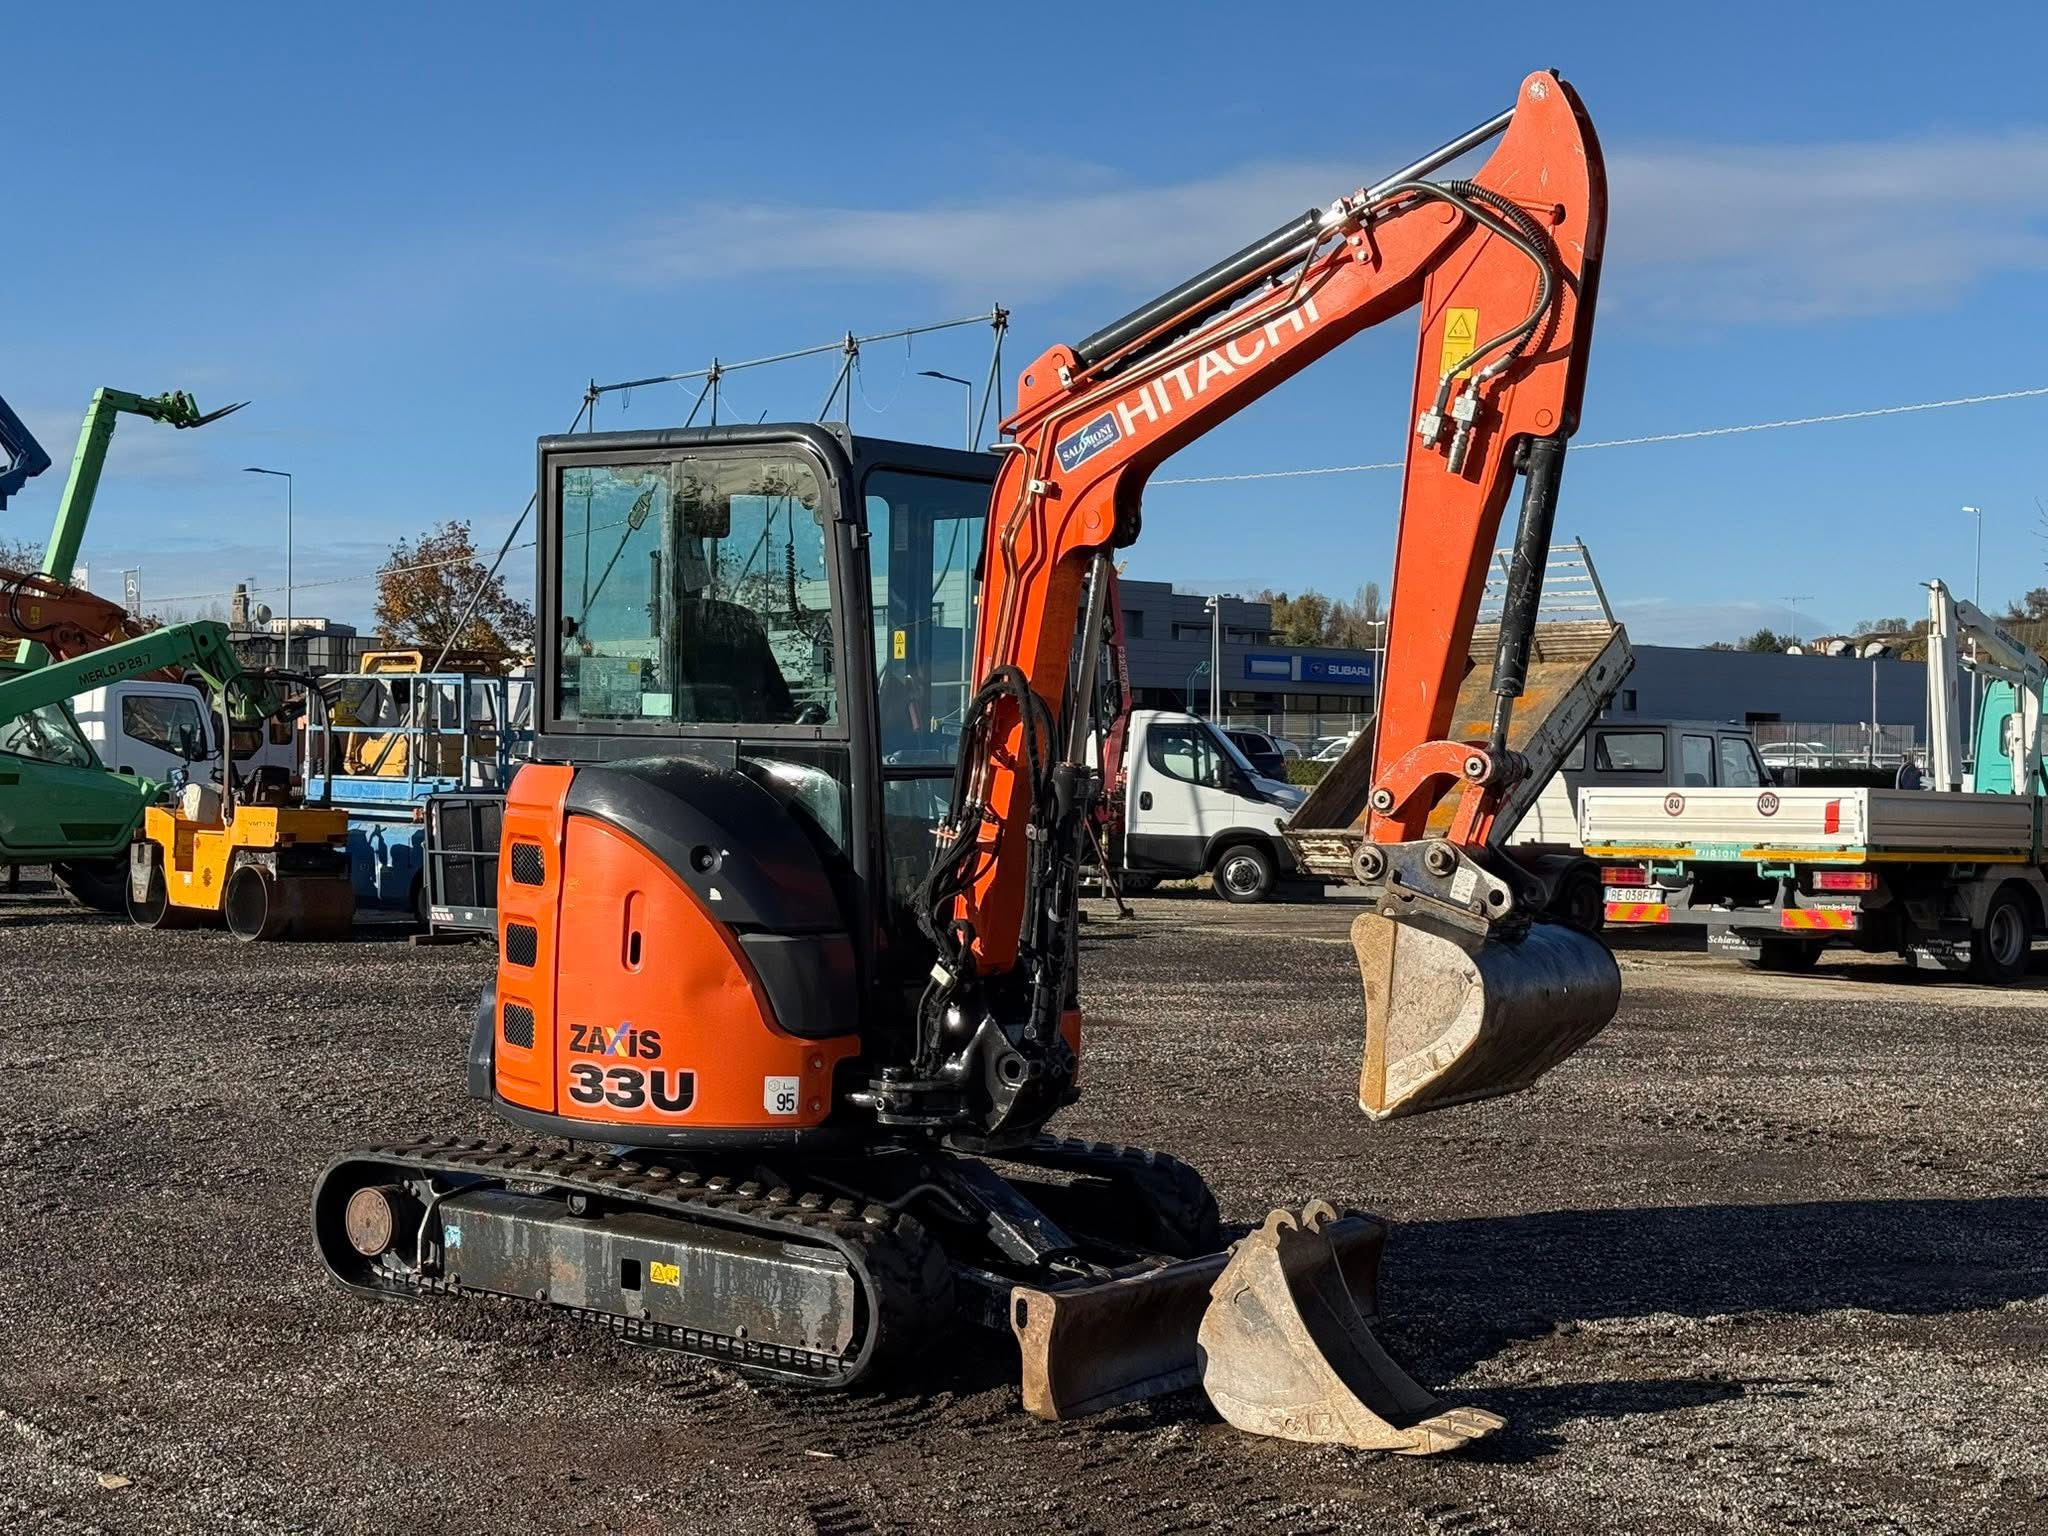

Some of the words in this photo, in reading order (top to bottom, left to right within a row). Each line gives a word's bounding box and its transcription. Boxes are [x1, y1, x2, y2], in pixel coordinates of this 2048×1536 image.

[1115, 285, 1321, 438] HITACHI
[78, 664, 118, 686] MERLO
[118, 662, 127, 674] P
[1327, 664, 1371, 677] SUBARU
[1668, 798, 1680, 809] 80
[1760, 798, 1776, 809] 100
[568, 1062, 695, 1113] 33U
[776, 1093, 795, 1112] 95
